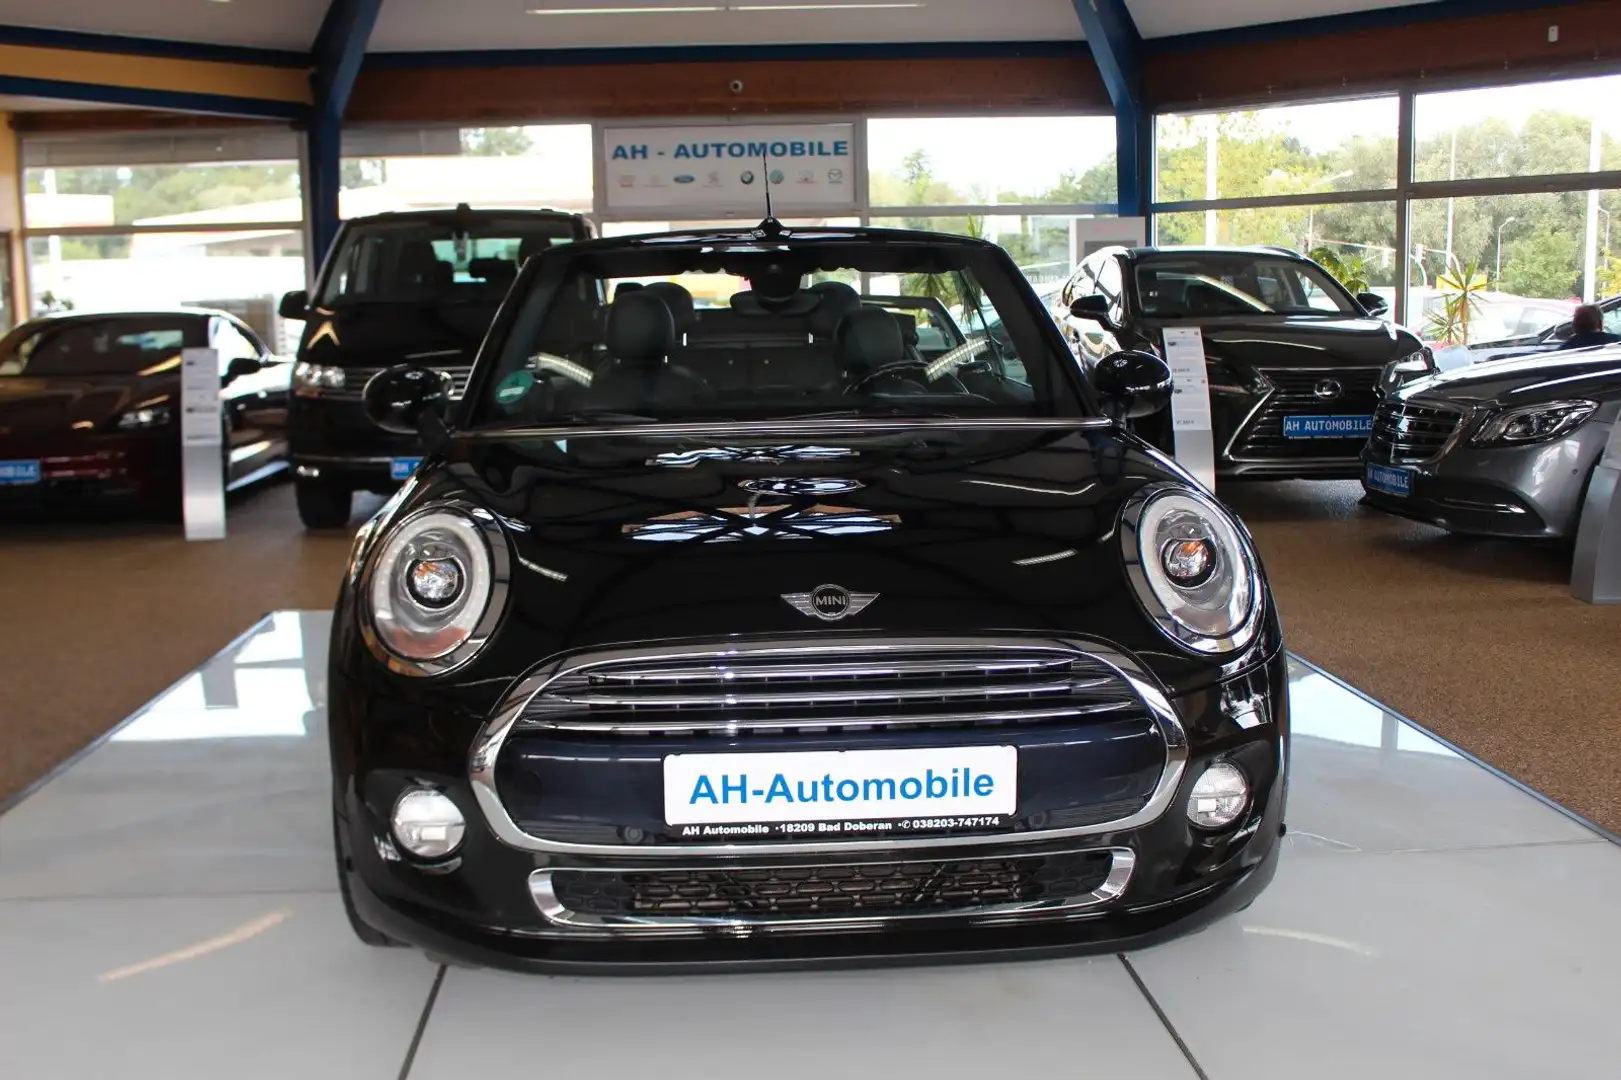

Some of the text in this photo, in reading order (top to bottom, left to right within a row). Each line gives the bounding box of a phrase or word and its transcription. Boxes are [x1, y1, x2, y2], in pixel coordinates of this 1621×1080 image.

[612, 145, 648, 160] AH
[673, 141, 848, 159] AUTOMOBILE
[1286, 419, 1373, 431] AH AUTOMOBILE
[814, 595, 846, 606] MINI
[689, 767, 995, 804] AH-Automobile
[682, 826, 700, 836] AH
[703, 824, 770, 835] Automobile
[818, 821, 841, 832] Bad
[844, 821, 893, 832] Doberan
